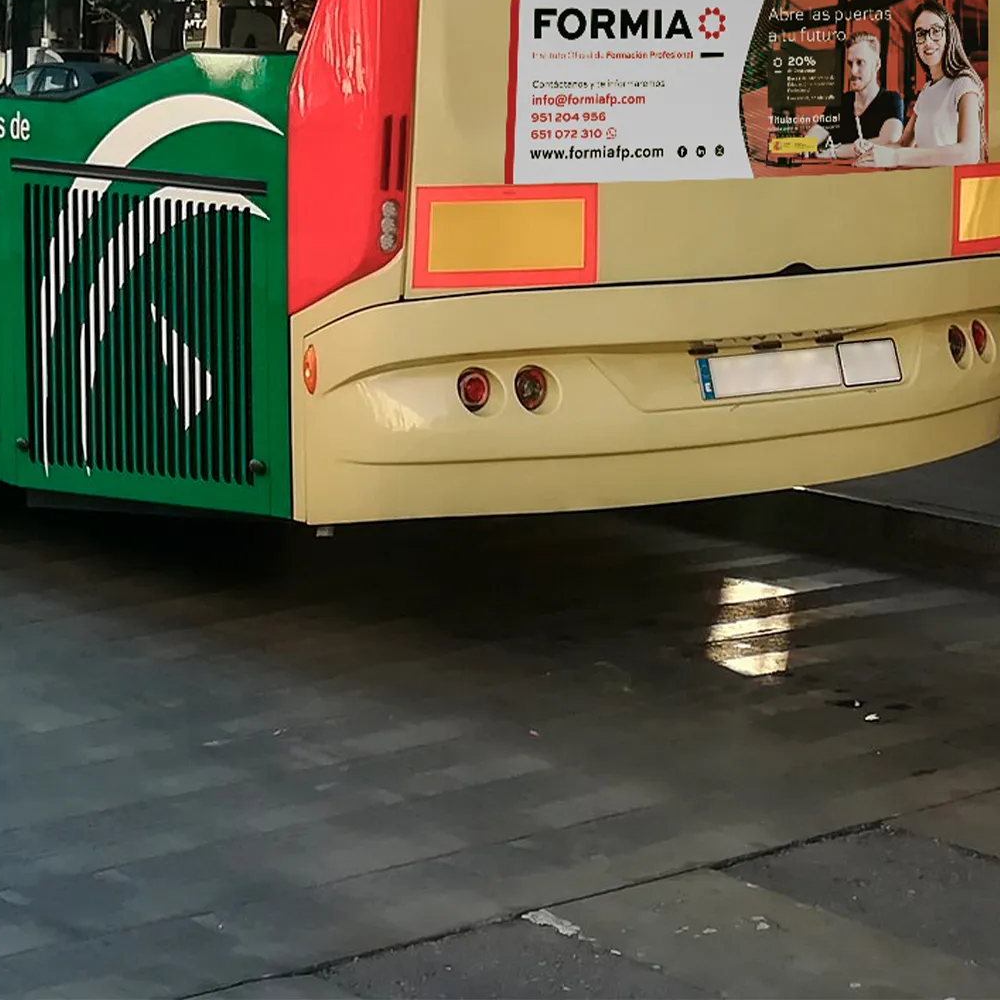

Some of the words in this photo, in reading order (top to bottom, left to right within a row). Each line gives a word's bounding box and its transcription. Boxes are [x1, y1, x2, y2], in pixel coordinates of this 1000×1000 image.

[768, 7, 804, 21] Abre
[809, 7, 831, 21] las
[835, 9, 892, 24] puertas
[534, 7, 693, 40] FORMIA
[768, 31, 777, 42] a
[800, 27, 847, 42] futuro
[788, 56, 817, 66] 20%
[532, 93, 646, 107] info@formiafp.com
[531, 112, 552, 122] 951
[555, 112, 580, 122] 204
[10, 111, 31, 141] de
[531, 129, 552, 139] 651
[555, 129, 578, 139] 072
[581, 129, 602, 139] 310
[530, 145, 664, 161] www.formiafp.com
